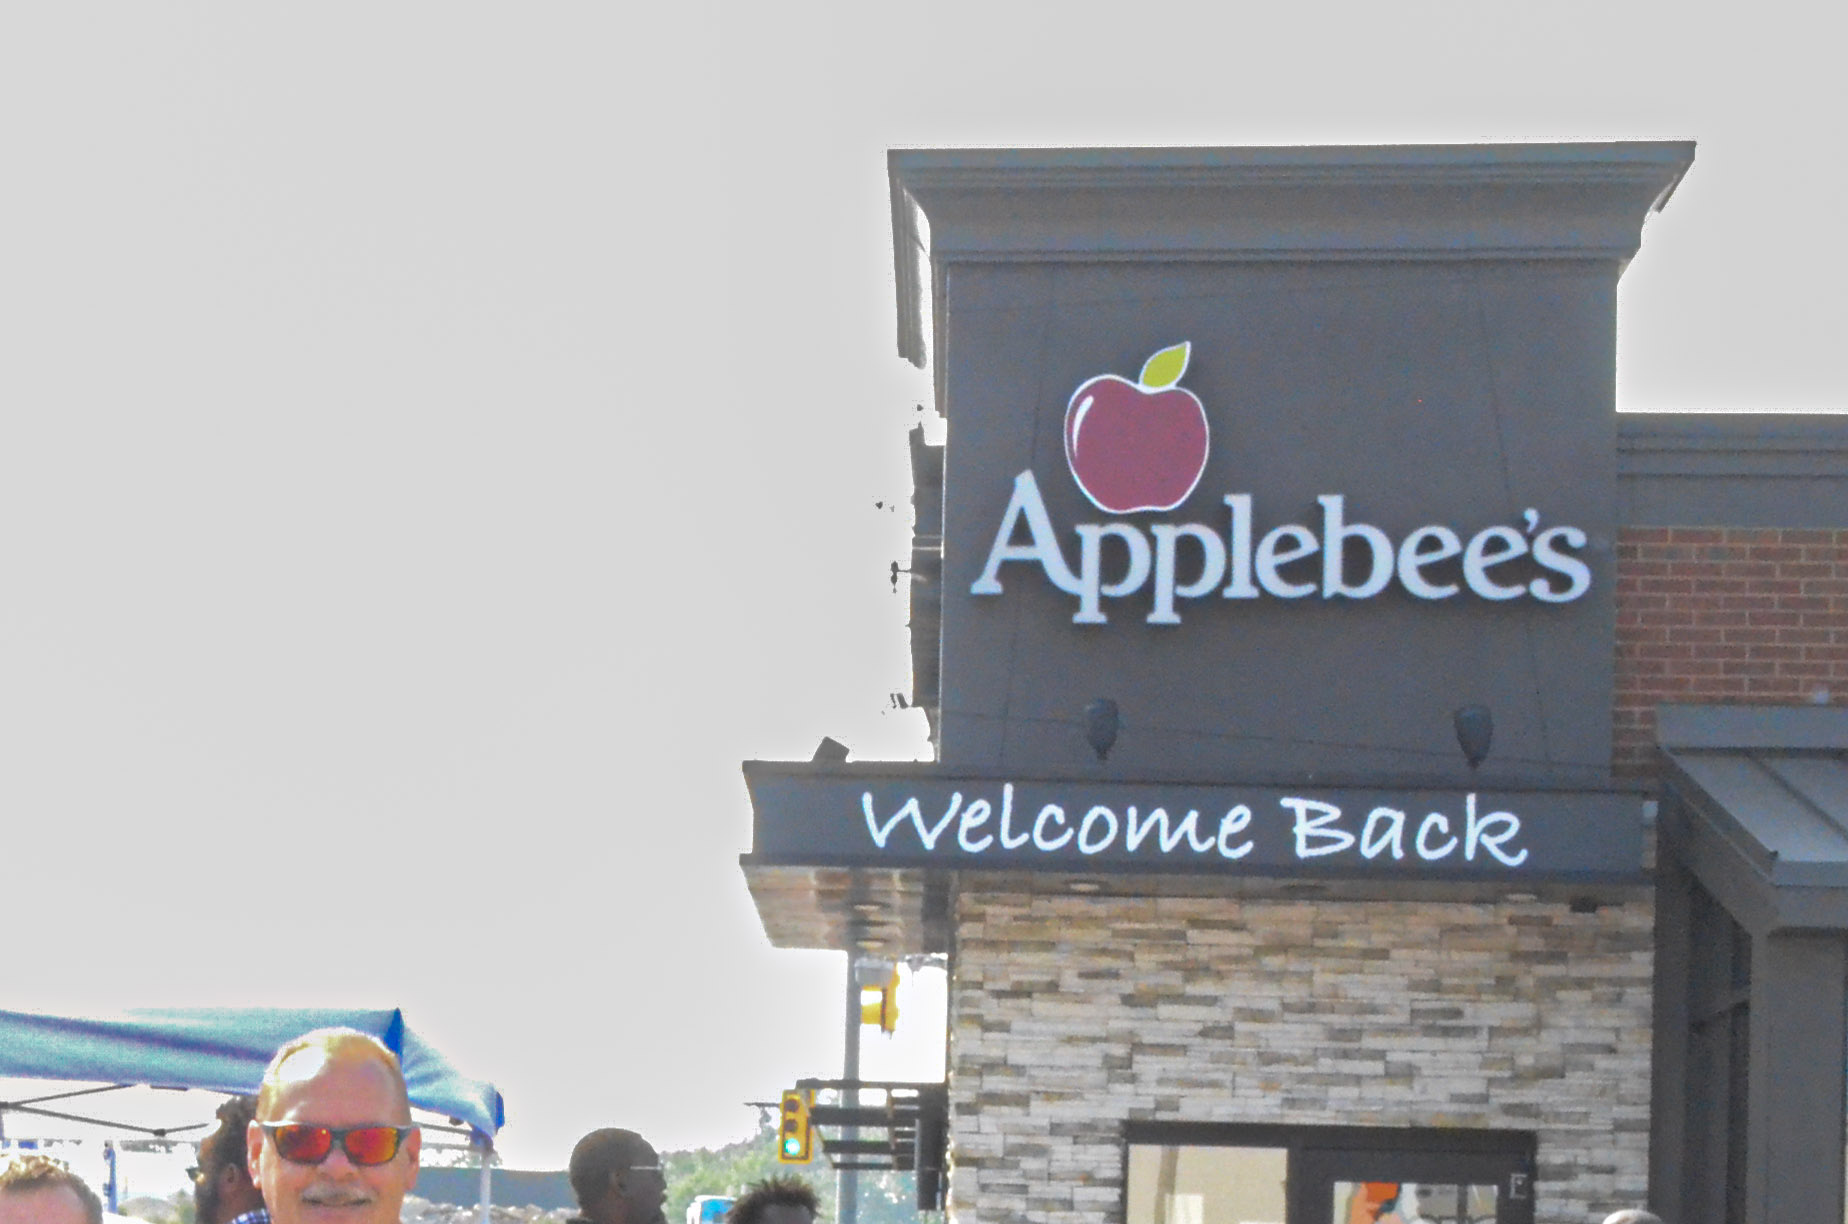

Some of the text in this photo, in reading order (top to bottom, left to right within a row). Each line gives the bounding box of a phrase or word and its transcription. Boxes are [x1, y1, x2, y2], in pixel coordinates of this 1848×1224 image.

[970, 469, 1593, 625] Applebee's
[861, 784, 1529, 867] Welcome Back
